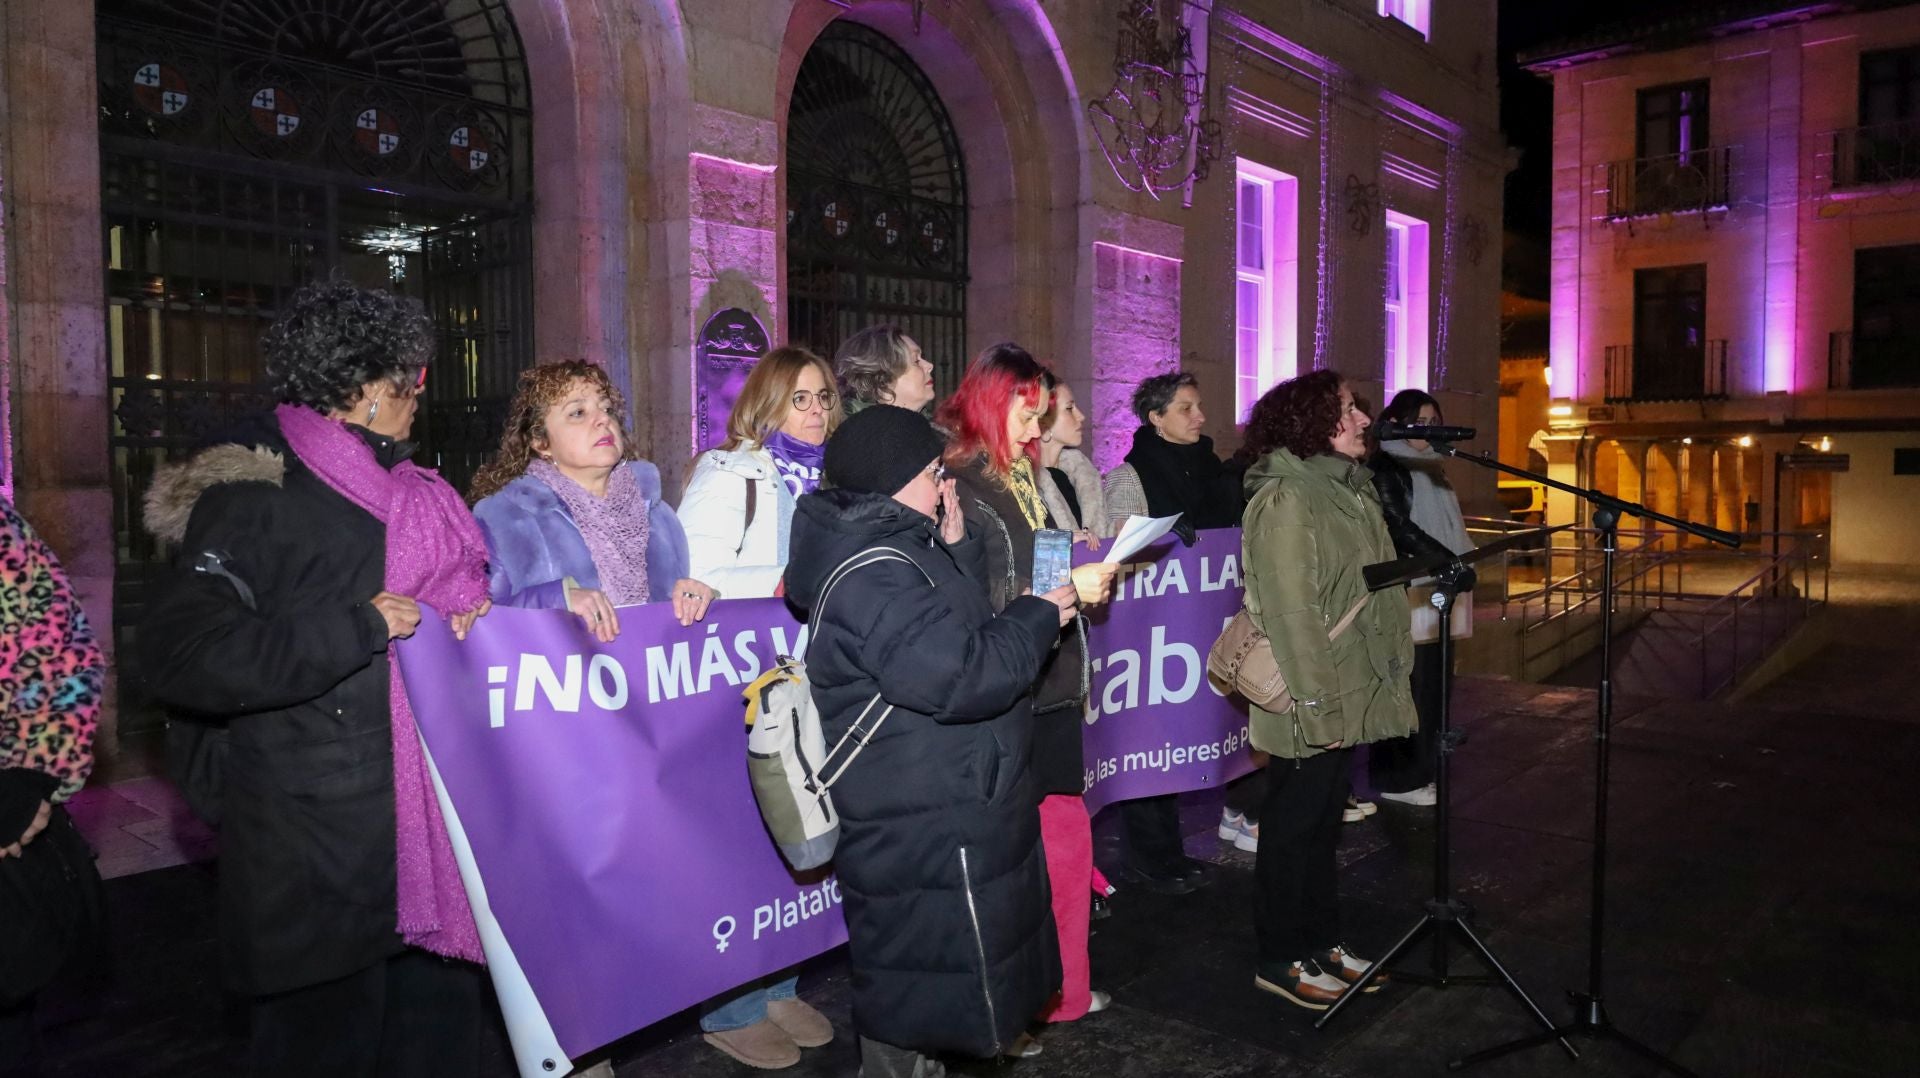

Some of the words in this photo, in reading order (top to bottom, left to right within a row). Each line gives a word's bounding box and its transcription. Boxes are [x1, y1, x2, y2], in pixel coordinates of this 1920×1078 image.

[488, 653, 628, 728] ¡NO
[646, 623, 760, 704] MÁS
[1093, 559, 1189, 606] TRA
[1201, 554, 1244, 592] LA
[1097, 758, 1117, 782] las
[1123, 742, 1220, 772] mujeres
[1223, 731, 1238, 756] de
